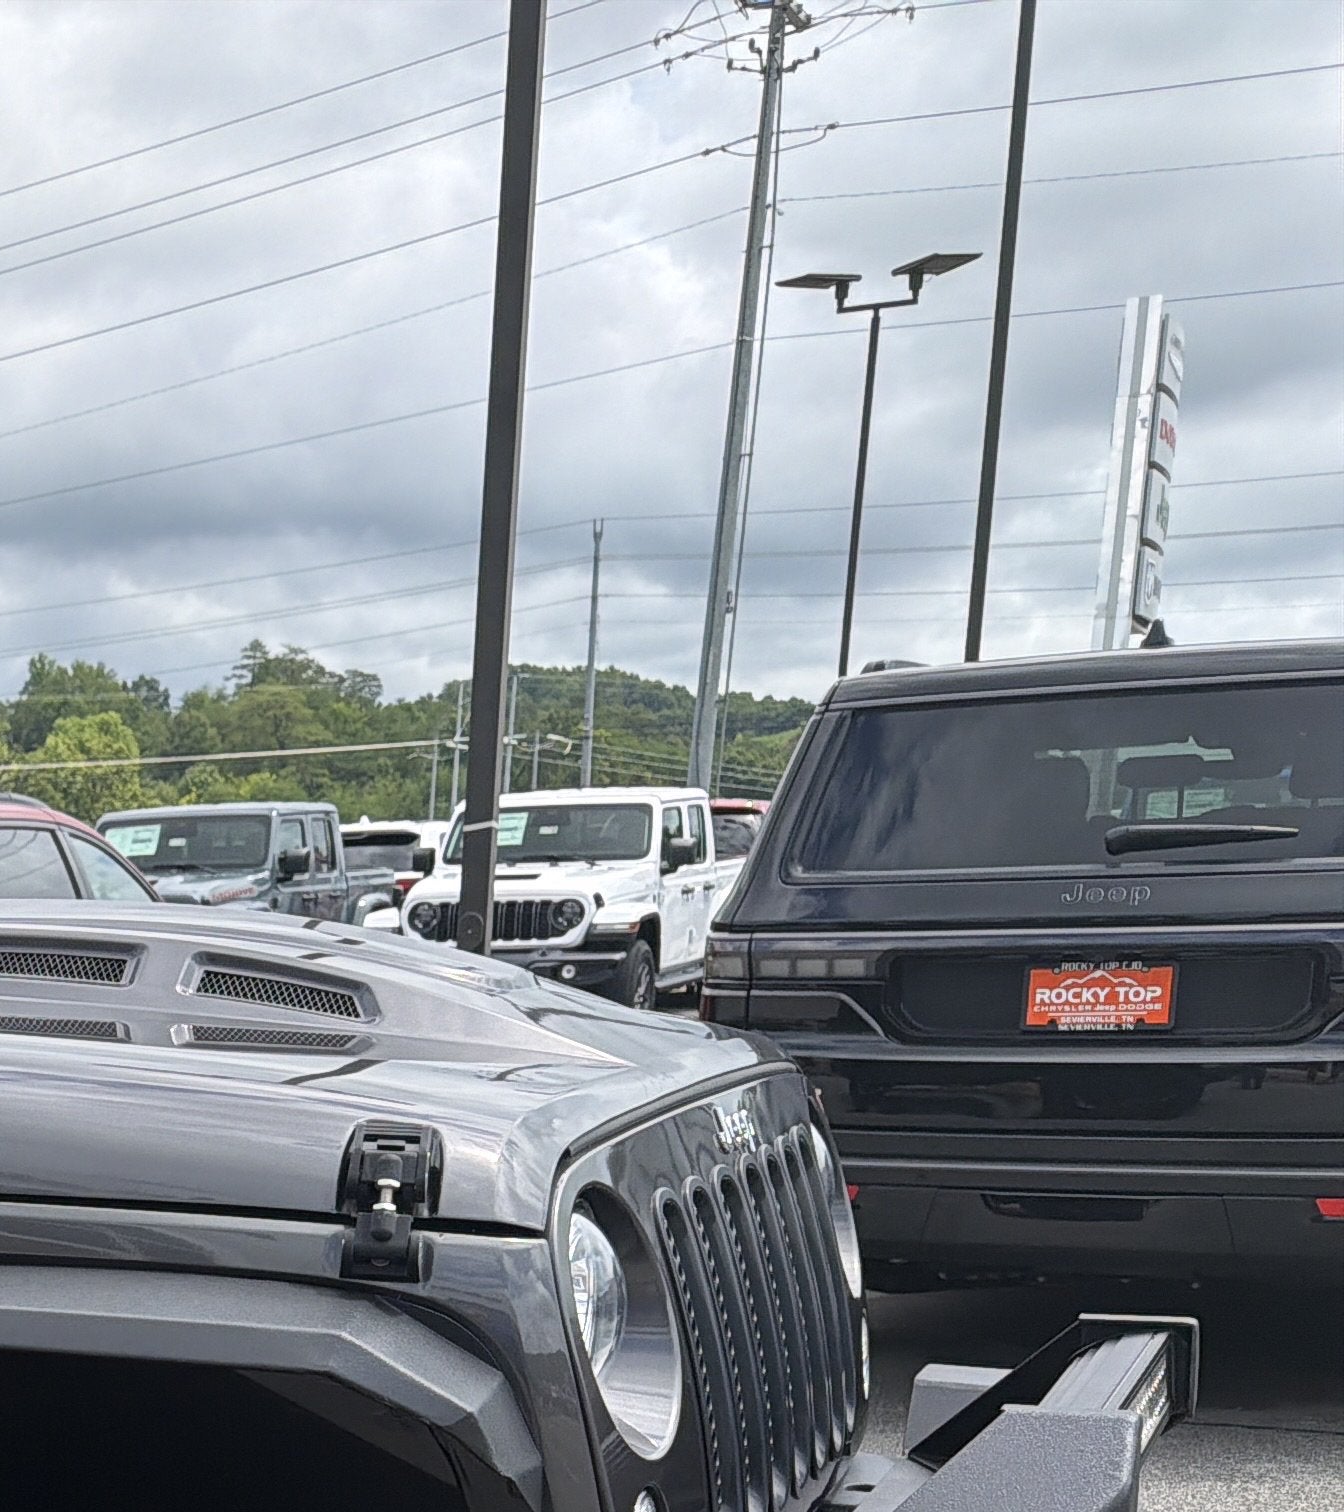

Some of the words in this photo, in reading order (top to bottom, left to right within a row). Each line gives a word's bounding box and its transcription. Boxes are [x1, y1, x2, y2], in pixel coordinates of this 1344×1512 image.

[1061, 883, 1151, 906] Jeep
[1061, 961, 1095, 972] ROCKY
[1099, 961, 1120, 971] TOP
[1035, 986, 1111, 1004] ROCKY
[1114, 986, 1163, 1003] TOP
[1033, 1004, 1092, 1012] CHRYSLER
[1093, 1003, 1116, 1012] Jeep
[1119, 1002, 1163, 1010] DODGE
[1121, 1015, 1134, 1023] TN
[1121, 1023, 1135, 1031] TN
